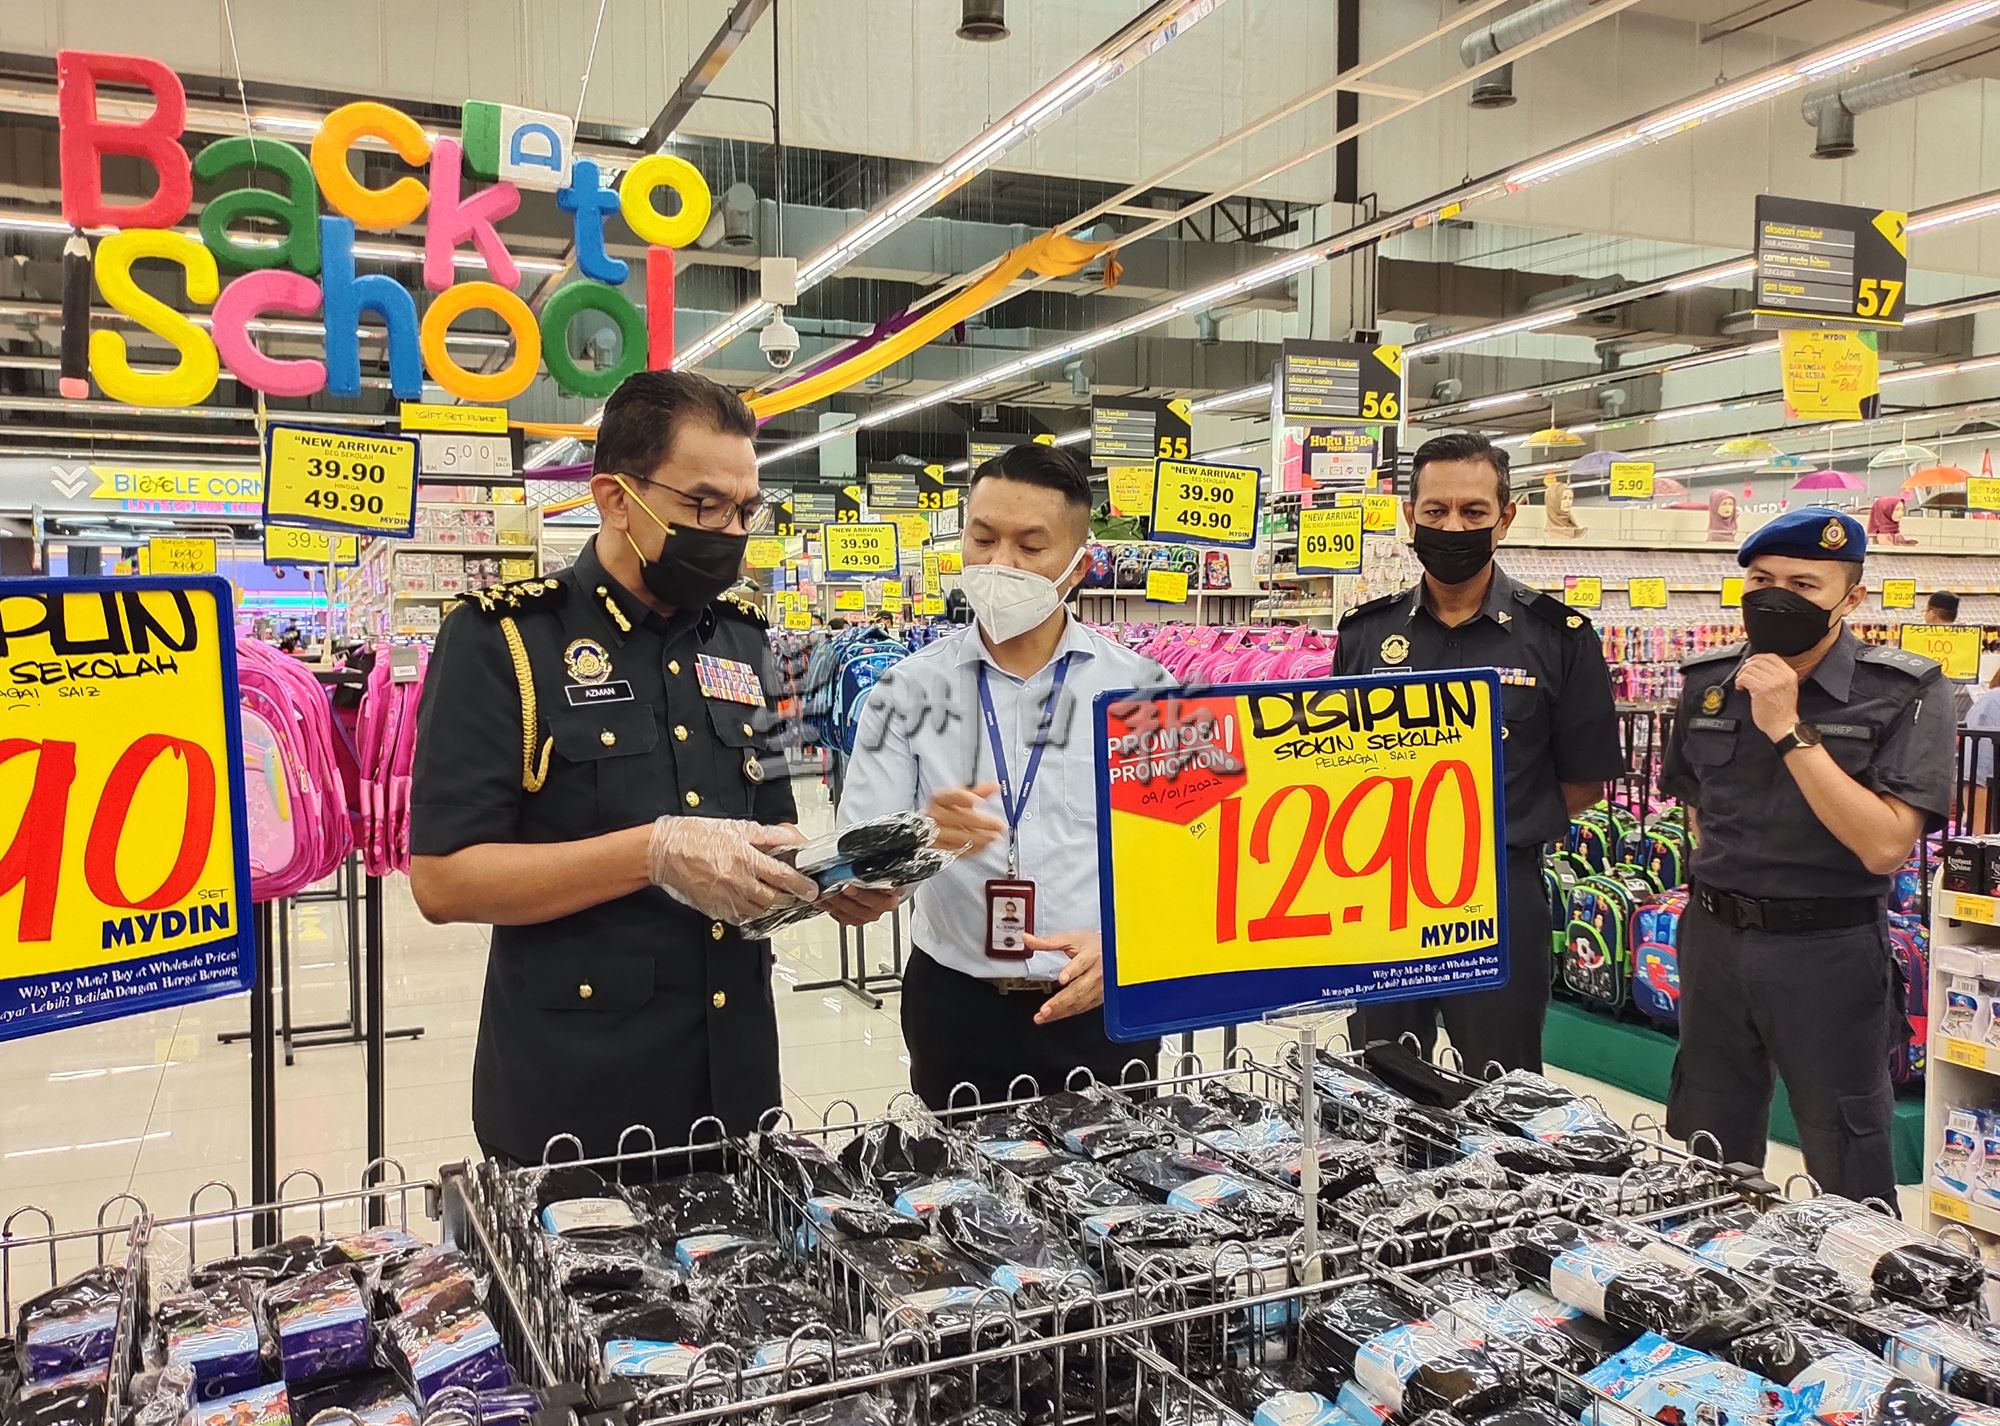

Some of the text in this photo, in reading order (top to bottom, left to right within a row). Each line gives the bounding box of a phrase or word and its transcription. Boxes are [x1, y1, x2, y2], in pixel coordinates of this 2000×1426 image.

[58, 49, 710, 291] Back to
[1765, 223, 1823, 239] aksesori rambut
[1763, 253, 1788, 263] cermin
[1790, 256, 1808, 265] mata
[1763, 280, 1804, 296] jam tangan
[1856, 278, 1903, 317] 57
[90, 216, 674, 407] School
[1841, 349, 1861, 360] Jom
[1362, 391, 1398, 419] 56
[1159, 437, 1188, 459] 55
[307, 458, 385, 484] 39.90
[1179, 484, 1234, 503] 39.90
[1618, 480, 1643, 490] 5.90
[304, 489, 384, 514] 49.90
[918, 492, 941, 509] 53
[837, 510, 859, 523] 52
[1177, 510, 1231, 529] 49.90
[778, 523, 795, 535] 51
[841, 539, 878, 549] 39.90
[1307, 534, 1354, 552] 69.90
[842, 555, 880, 565] 49.90
[1574, 592, 1593, 601] 2.00
[9, 655, 179, 685] SEKOLAH
[58, 686, 101, 698] SAIZ
[586, 688, 615, 698] AZMAN
[1108, 719, 1220, 759] PROMOSI
[1274, 728, 1462, 761] STOKIN SEKOLAH
[1315, 751, 1417, 769] PELBAGAI SAIZ
[1142, 778, 1222, 804] 09/01/2022
[1216, 760, 1481, 943] 12.90
[1948, 856, 1972, 866] Instant
[1951, 863, 1971, 872] Shine
[198, 889, 229, 900] SET
[1464, 905, 1483, 913] SET
[102, 902, 230, 950] MYDIN
[1421, 918, 1494, 948] MYDIN
[18, 986, 48, 1000] Why
[51, 980, 73, 994] Pay
[77, 972, 108, 990] More?
[112, 969, 133, 983] Buy
[136, 966, 147, 979] at
[149, 957, 203, 975] Wholesale
[31, 996, 70, 1015] Lebih?
[75, 990, 114, 1005] Belilah
[116, 982, 158, 998] Dengan
[162, 973, 197, 988] Harga
